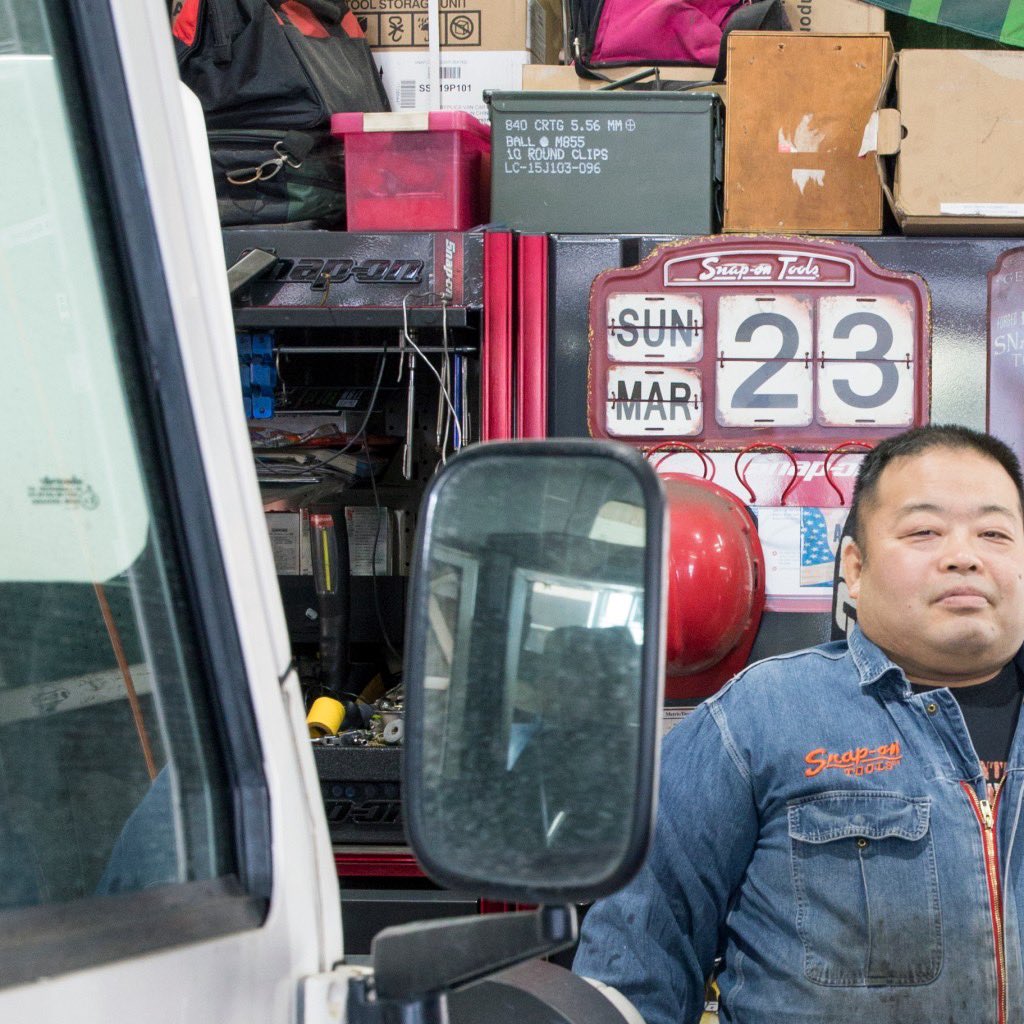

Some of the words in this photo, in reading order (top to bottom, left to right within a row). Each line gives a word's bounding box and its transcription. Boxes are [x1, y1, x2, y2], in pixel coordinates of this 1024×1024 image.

[379, 0, 429, 9] STORAG
[419, 84, 472, 93] SS19P101
[505, 119, 528, 132] 840
[534, 119, 564, 131] CRTG
[571, 119, 601, 132] 5.56
[607, 119, 623, 132] MM
[506, 136, 536, 147] BALL
[555, 136, 585, 148] M855
[507, 149, 522, 160] 10
[528, 149, 565, 160] ROUND
[571, 149, 609, 161] CLIPS
[504, 162, 601, 174] LC-15J103-096
[699, 256, 772, 281] Snap-on
[777, 256, 819, 280] Tools
[614, 308, 694, 348] SUN
[615, 380, 692, 421] MAR
[804, 739, 902, 777] Snap-on
